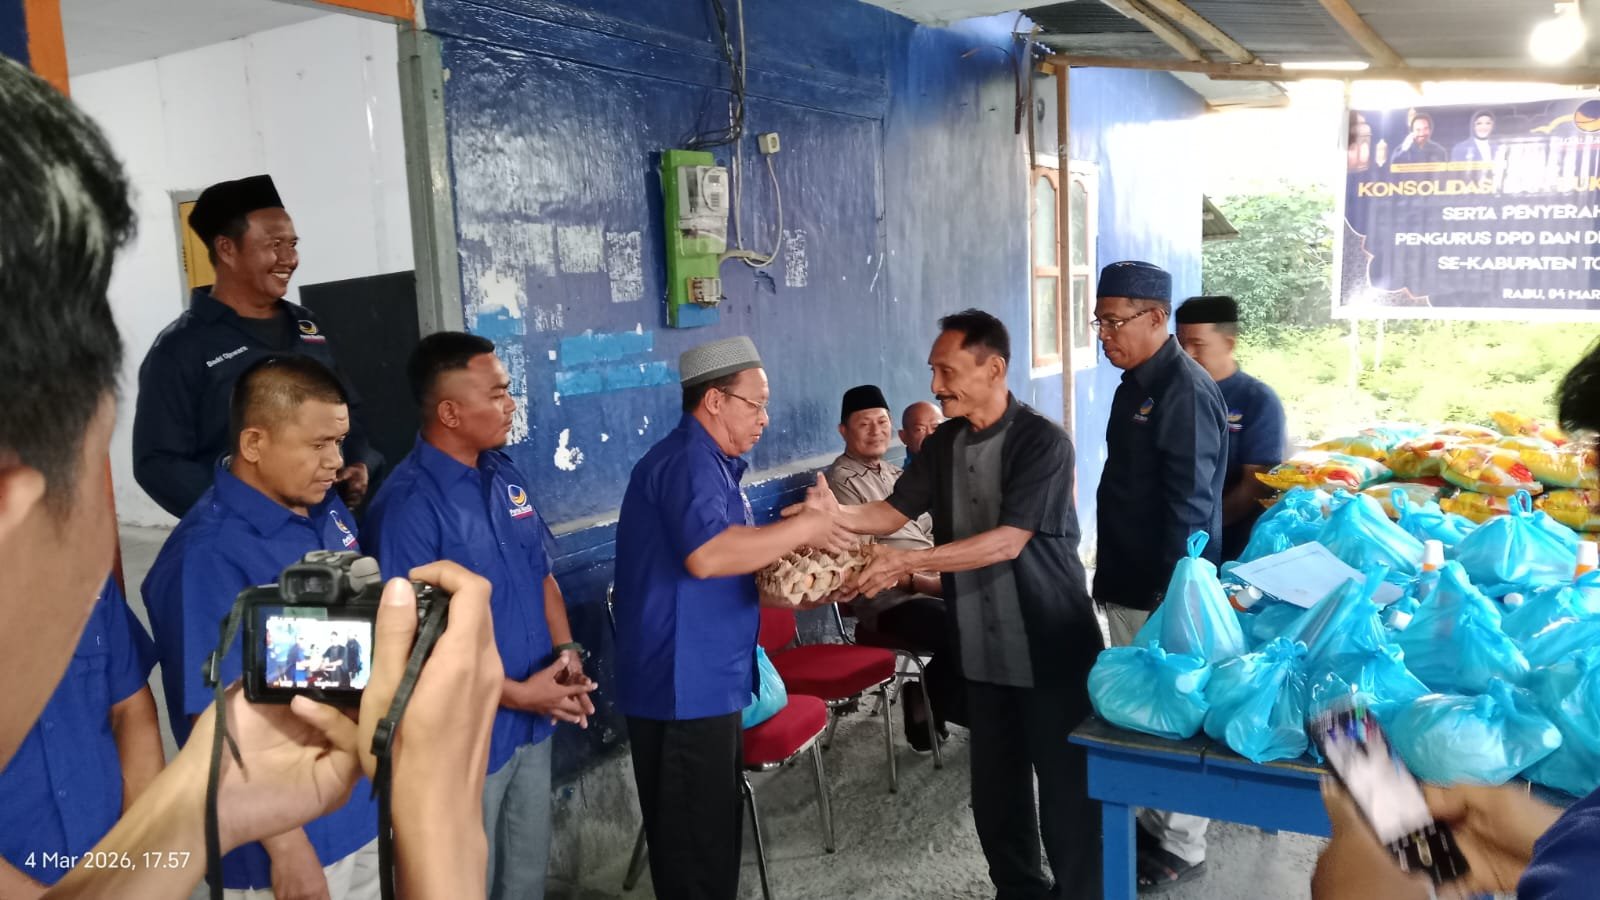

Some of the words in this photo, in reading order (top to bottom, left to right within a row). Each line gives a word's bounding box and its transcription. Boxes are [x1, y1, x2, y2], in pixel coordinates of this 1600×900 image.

[1442, 206, 1497, 220] SERTA
[1395, 231, 1491, 245] PENGURUS
[1496, 231, 1535, 245] DPD
[1539, 231, 1580, 244] DAN
[1438, 256, 1577, 270] SE-KABUPATEN
